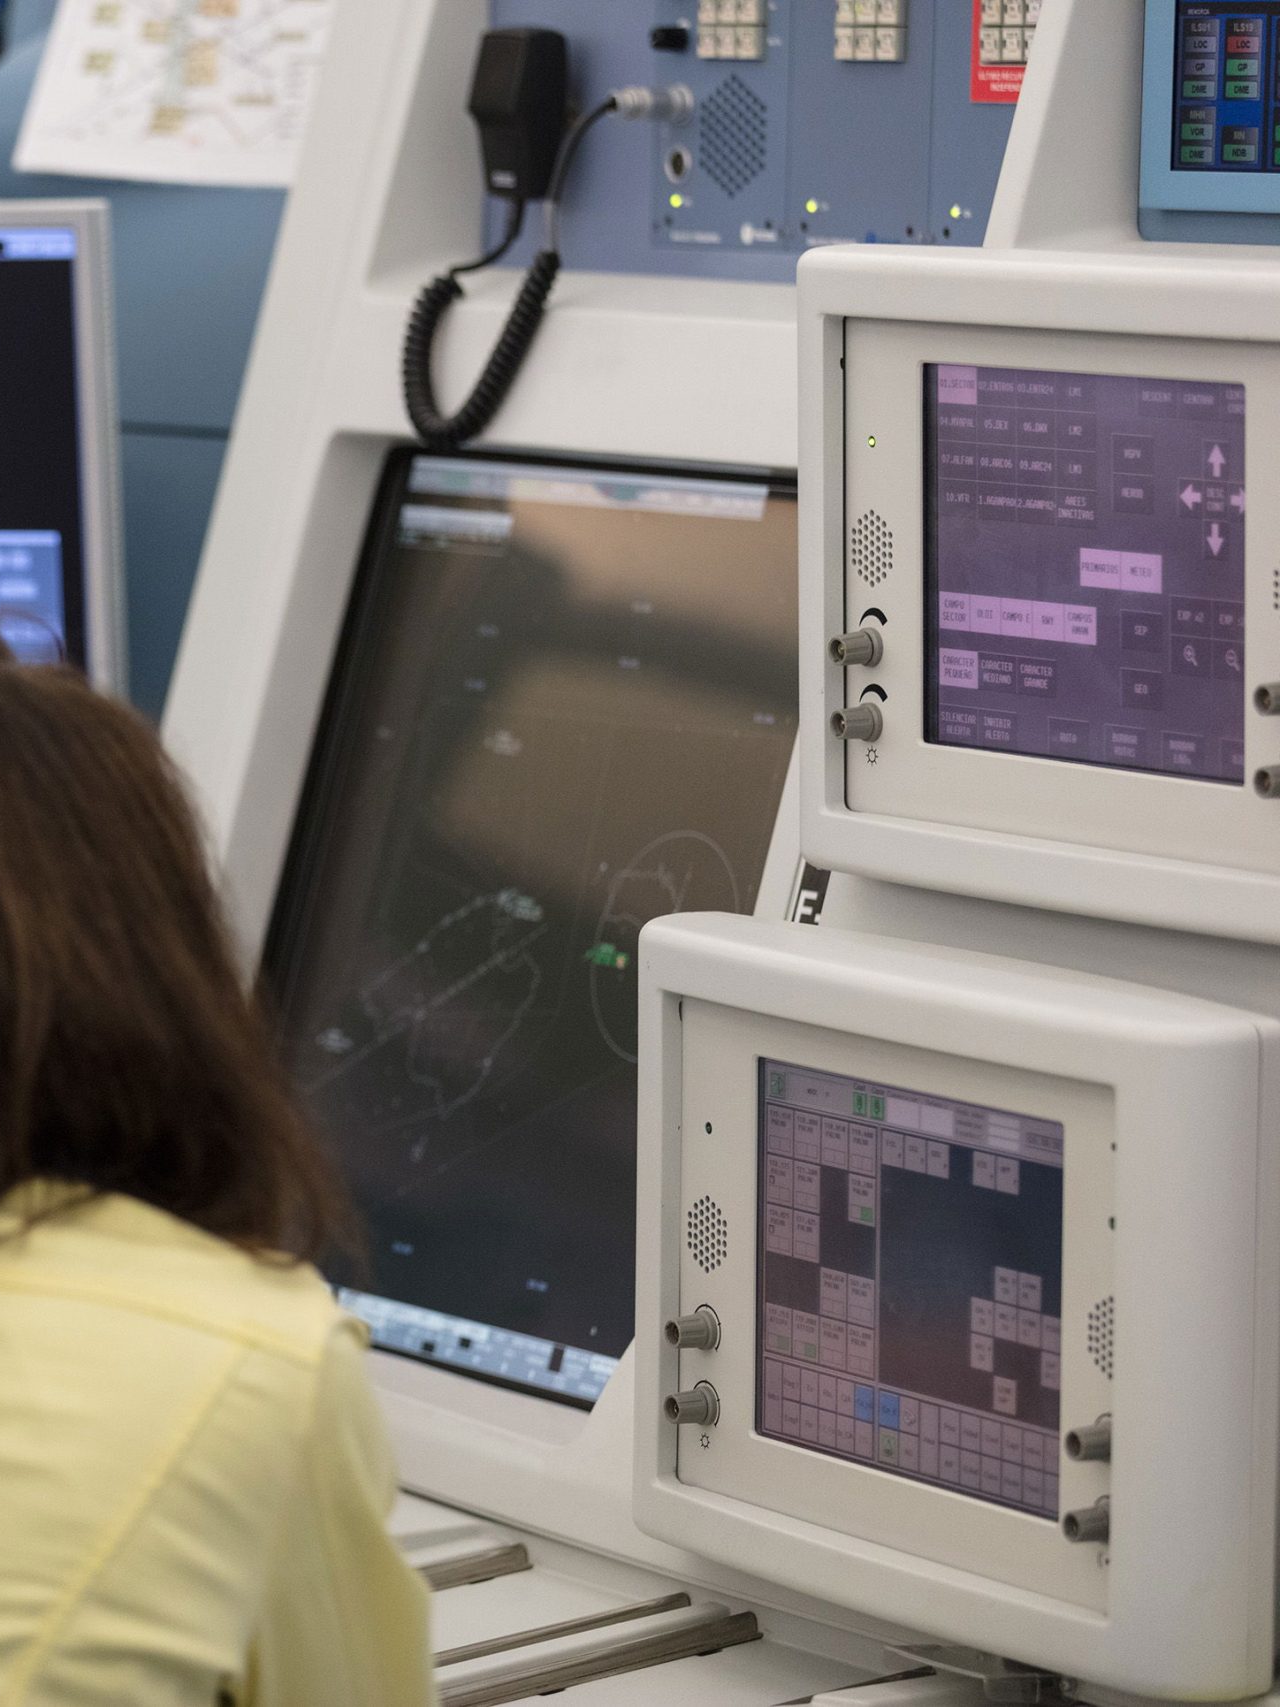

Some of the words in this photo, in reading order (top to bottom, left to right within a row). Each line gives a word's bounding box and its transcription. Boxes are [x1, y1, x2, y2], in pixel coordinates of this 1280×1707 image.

[1193, 40, 1208, 49] LOC
[1236, 40, 1251, 49] LOC
[1194, 63, 1206, 71] GP
[1237, 63, 1248, 71] GP
[1192, 85, 1207, 93] DME
[1234, 85, 1249, 94] DME
[1190, 128, 1204, 136] VOR
[1189, 150, 1204, 159] DME
[1232, 149, 1247, 157] NDB
[1081, 562, 1119, 574] PRIMARIOS
[943, 599, 965, 610] CAMPO
[942, 611, 967, 622] SECTOR
[1002, 611, 1023, 622] CAMPO
[1067, 612, 1093, 624] CAMPOS
[942, 655, 975, 667] CARACTER
[981, 659, 1013, 673] CARACTER
[1020, 664, 1053, 677] CARACTER
[982, 672, 1012, 685] MEDIANO
[1023, 677, 1049, 689] GRANDE
[941, 711, 977, 724] SILENCIAR
[946, 725, 971, 736] ALERTA
[985, 729, 1010, 741] ALERTA
